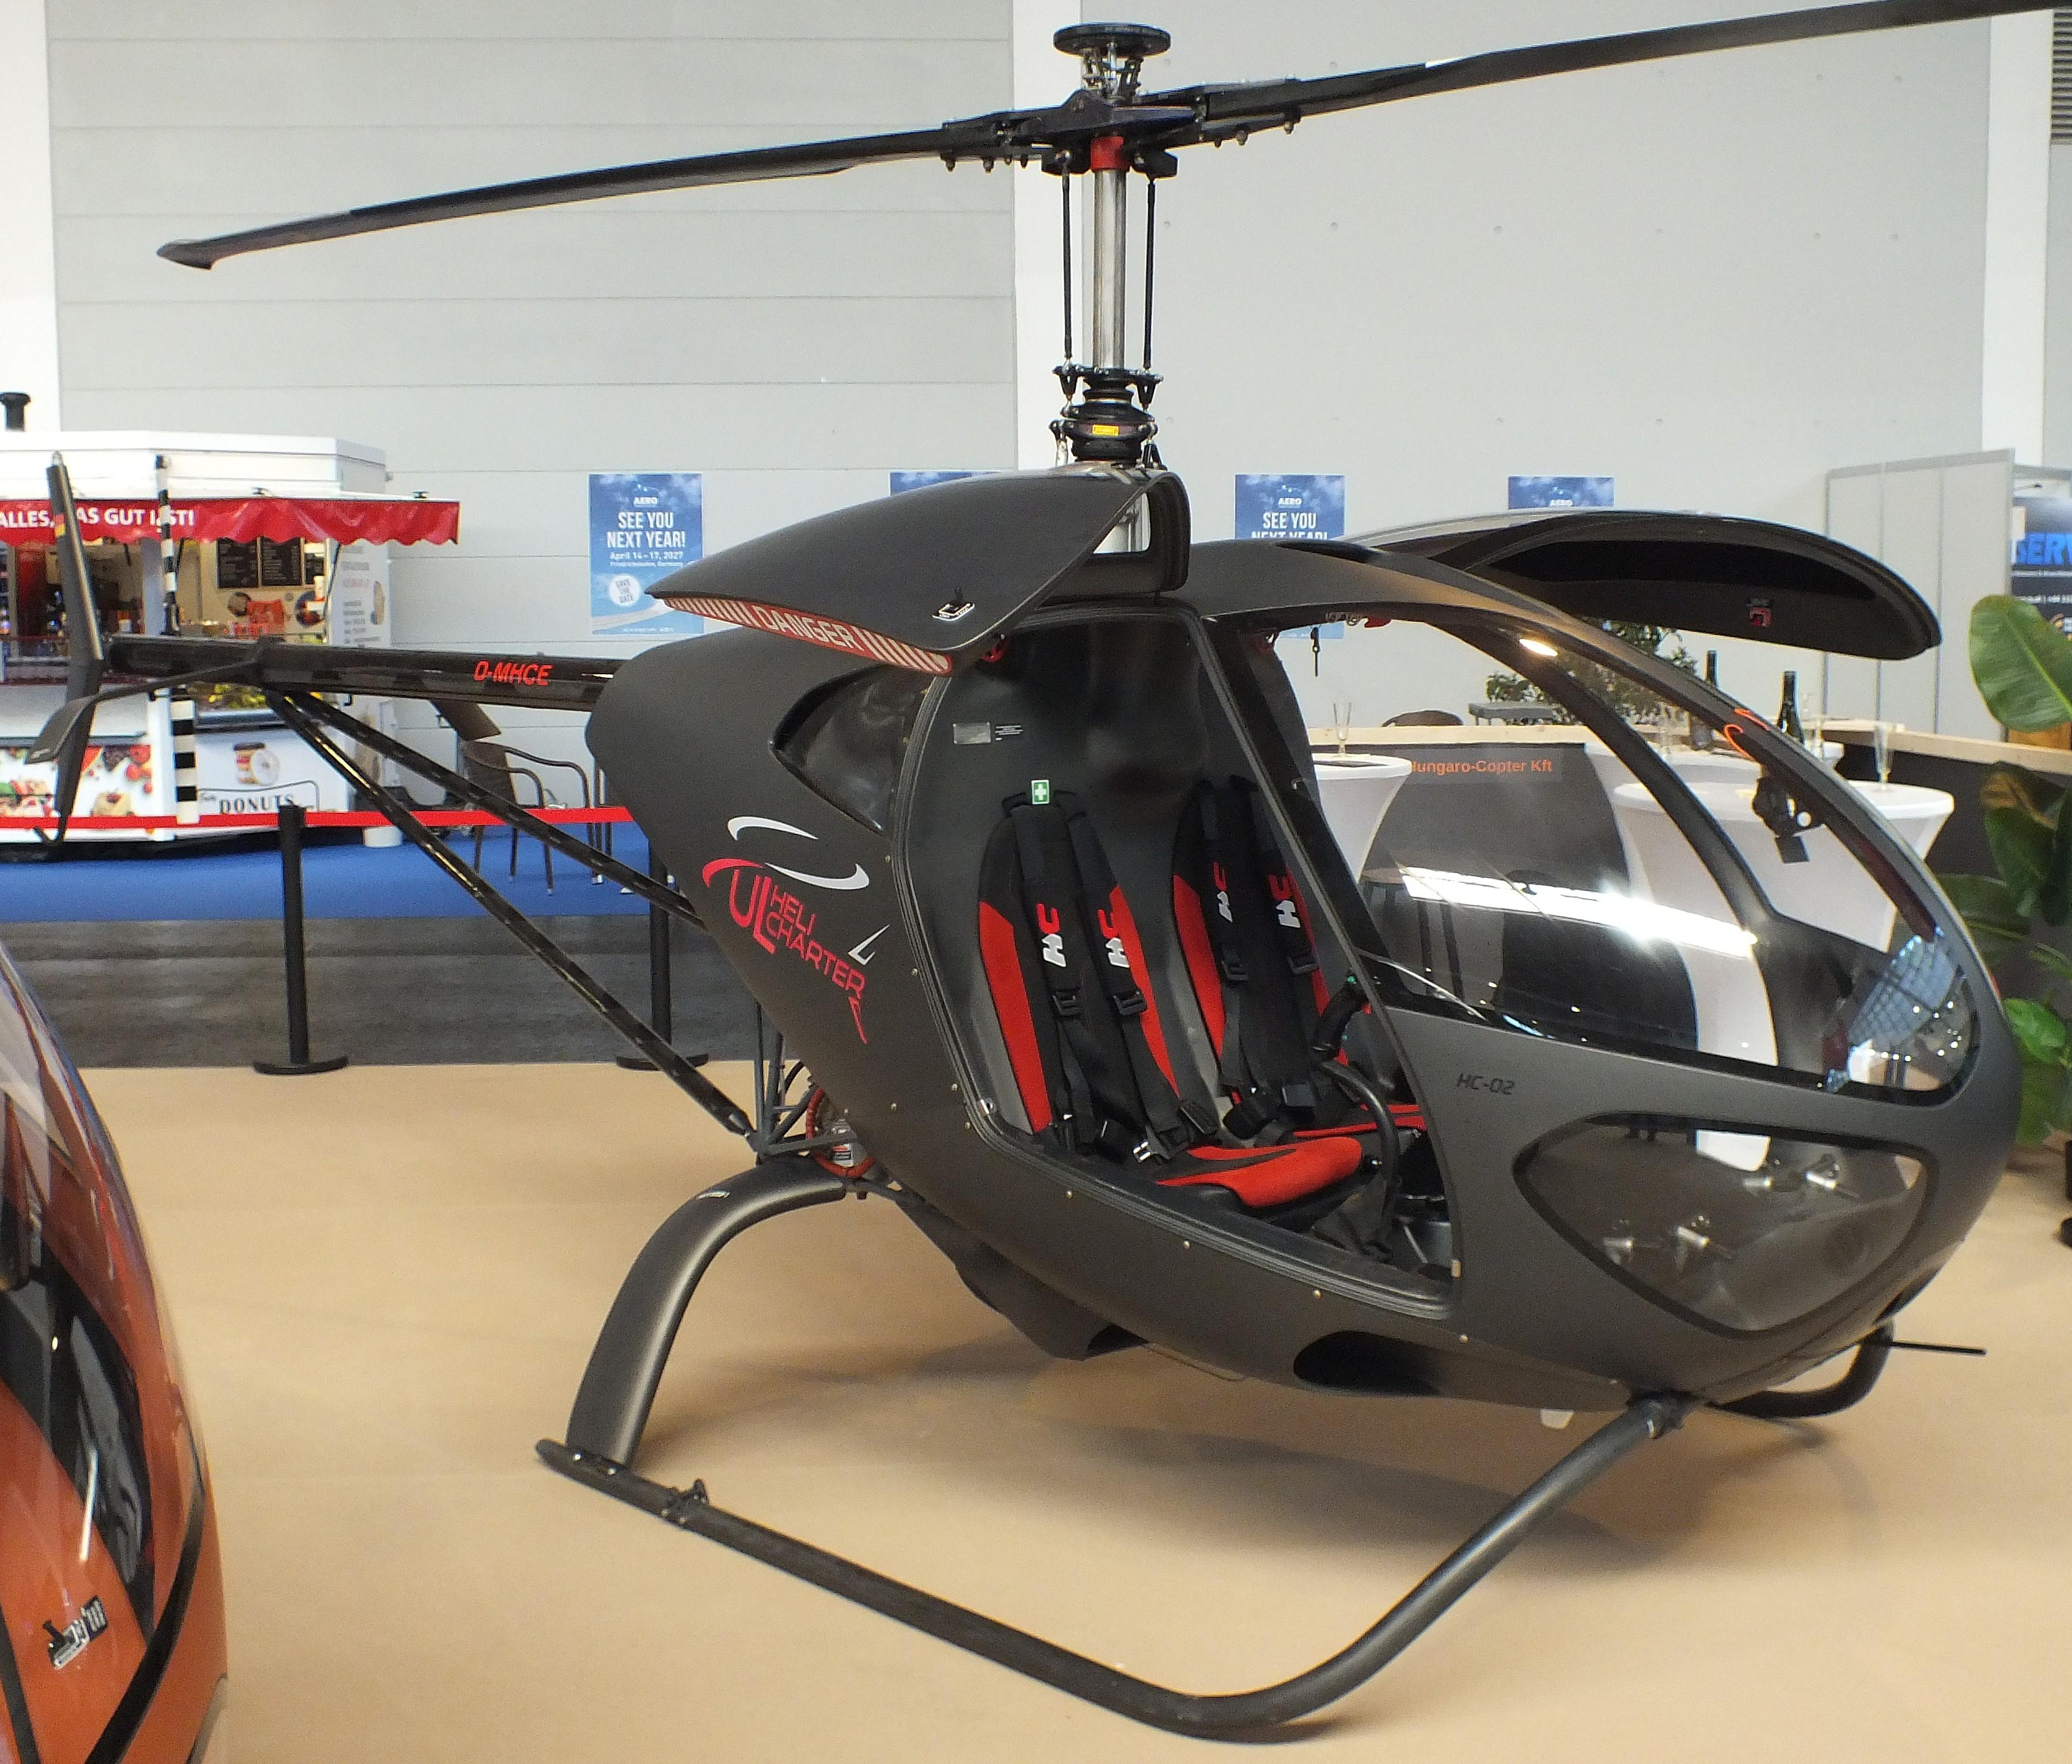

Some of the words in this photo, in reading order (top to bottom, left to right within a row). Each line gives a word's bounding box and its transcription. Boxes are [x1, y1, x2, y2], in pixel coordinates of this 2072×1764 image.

[104, 509, 145, 525] GUT
[618, 512, 643, 529] SEE
[647, 512, 674, 529] YOU
[1263, 512, 1287, 529] SEE
[1291, 512, 1316, 529] YOU
[607, 531, 642, 548] NEXT
[646, 531, 686, 548] YEAR!
[610, 552, 629, 560] April
[753, 606, 856, 649] DANGER
[1531, 759, 1552, 772] Kft
[770, 885, 818, 936] HELI
[766, 911, 867, 999] CHARTER
[1455, 1073, 1515, 1095] HC-02
